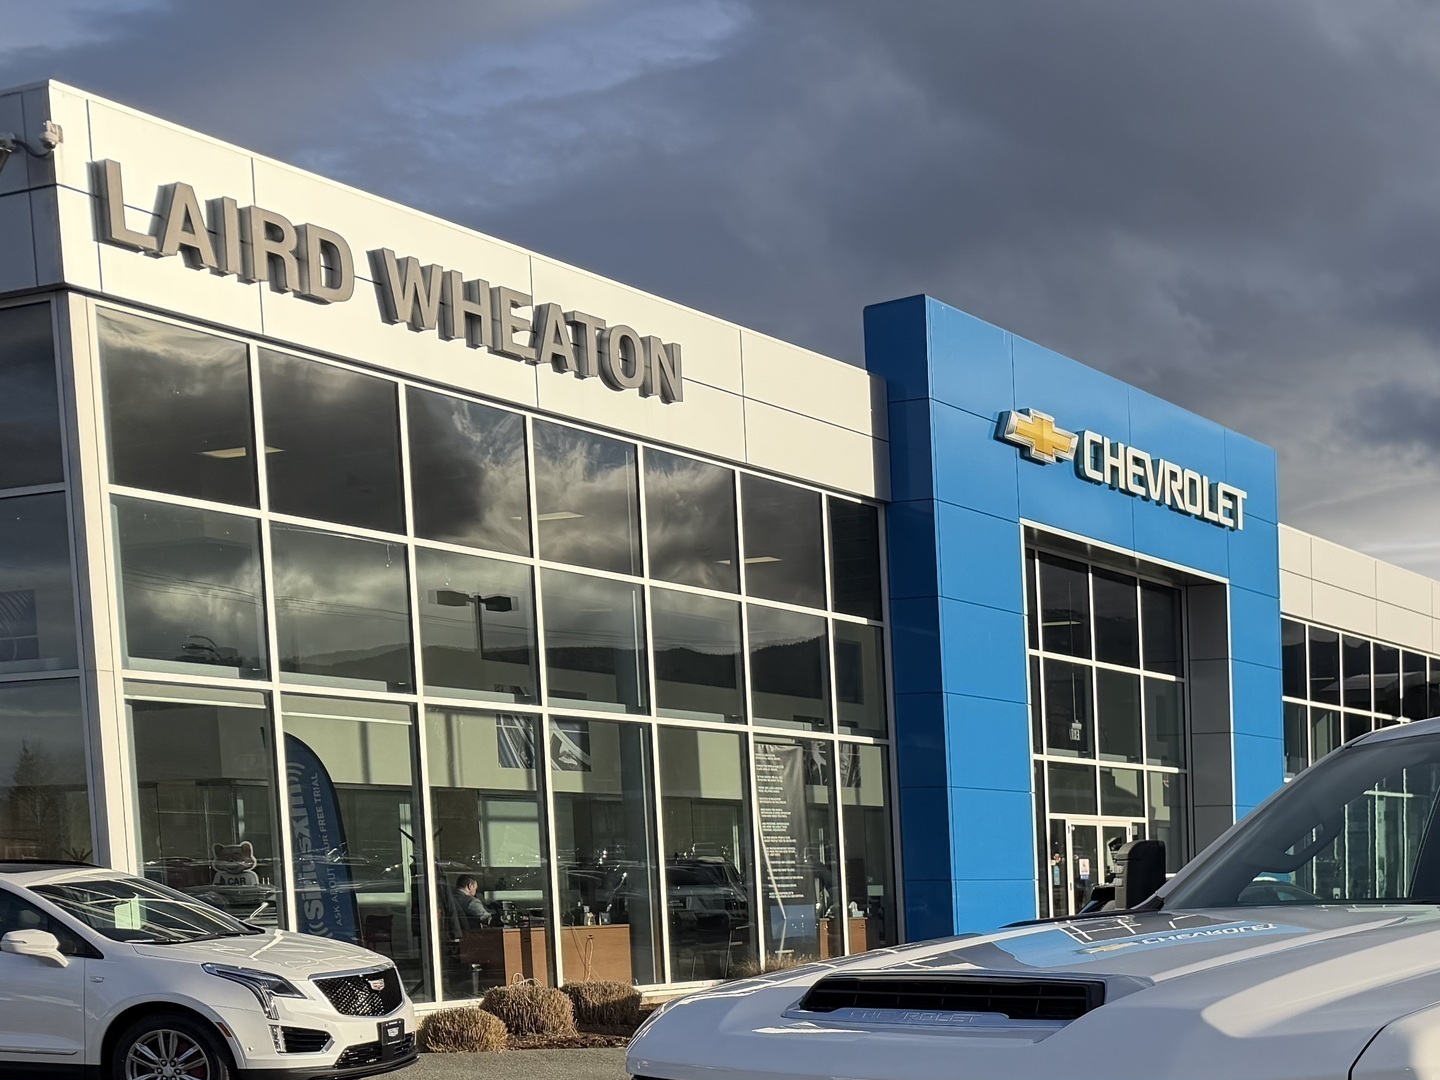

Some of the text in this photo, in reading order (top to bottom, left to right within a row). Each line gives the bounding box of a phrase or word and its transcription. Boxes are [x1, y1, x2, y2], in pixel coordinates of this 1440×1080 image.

[90, 158, 684, 404] LAIRD WHEATON
[1080, 429, 1248, 532] CHEVROLET
[311, 772, 322, 803] TRIAL
[316, 805, 327, 832] FREE
[328, 867, 340, 903] ABOUT
[332, 905, 343, 926] ASK
